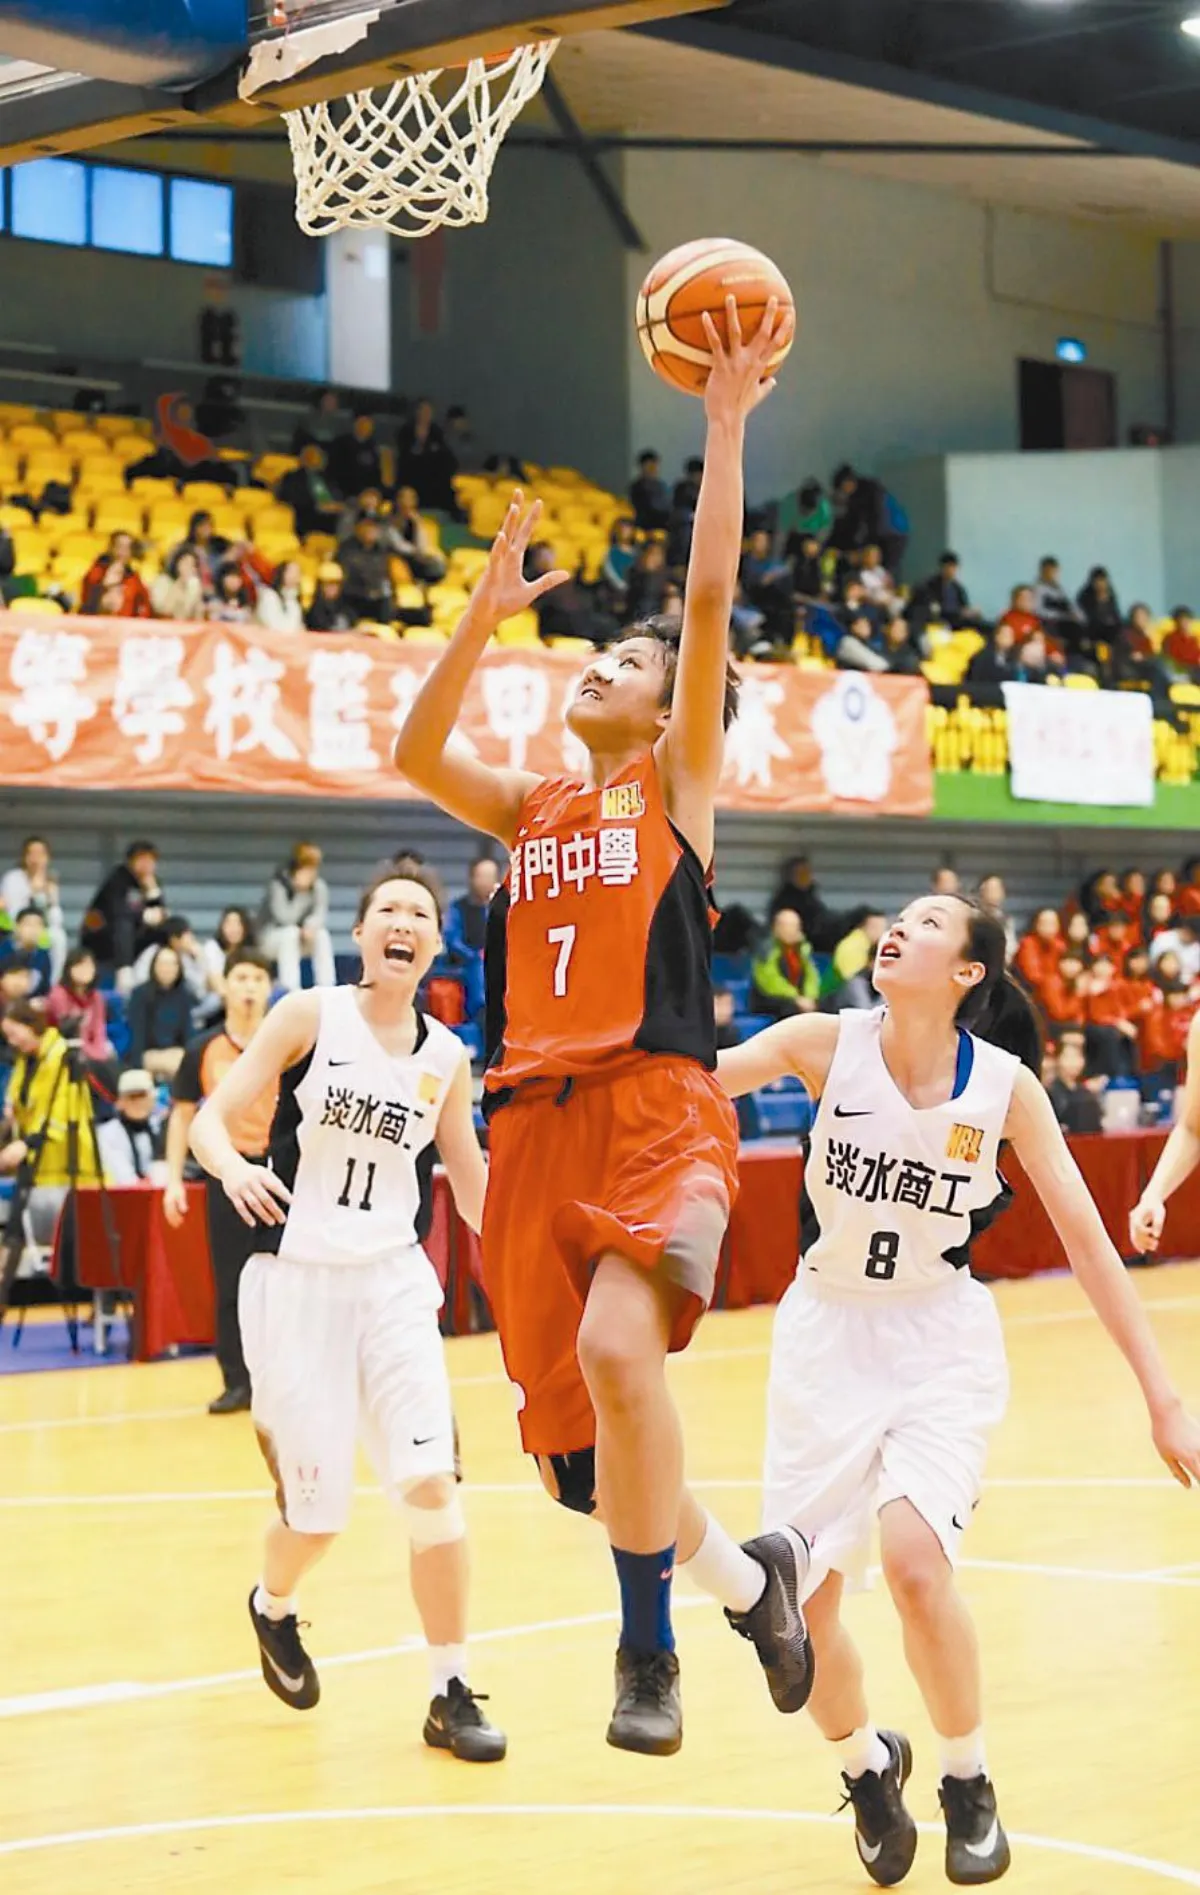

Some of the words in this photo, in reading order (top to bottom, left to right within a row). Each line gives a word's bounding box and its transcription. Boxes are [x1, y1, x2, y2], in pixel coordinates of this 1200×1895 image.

[547, 924, 576, 997] 7
[337, 1157, 376, 1211] 11
[825, 1138, 972, 1218] 淡水商工
[865, 1230, 900, 1280] 8
